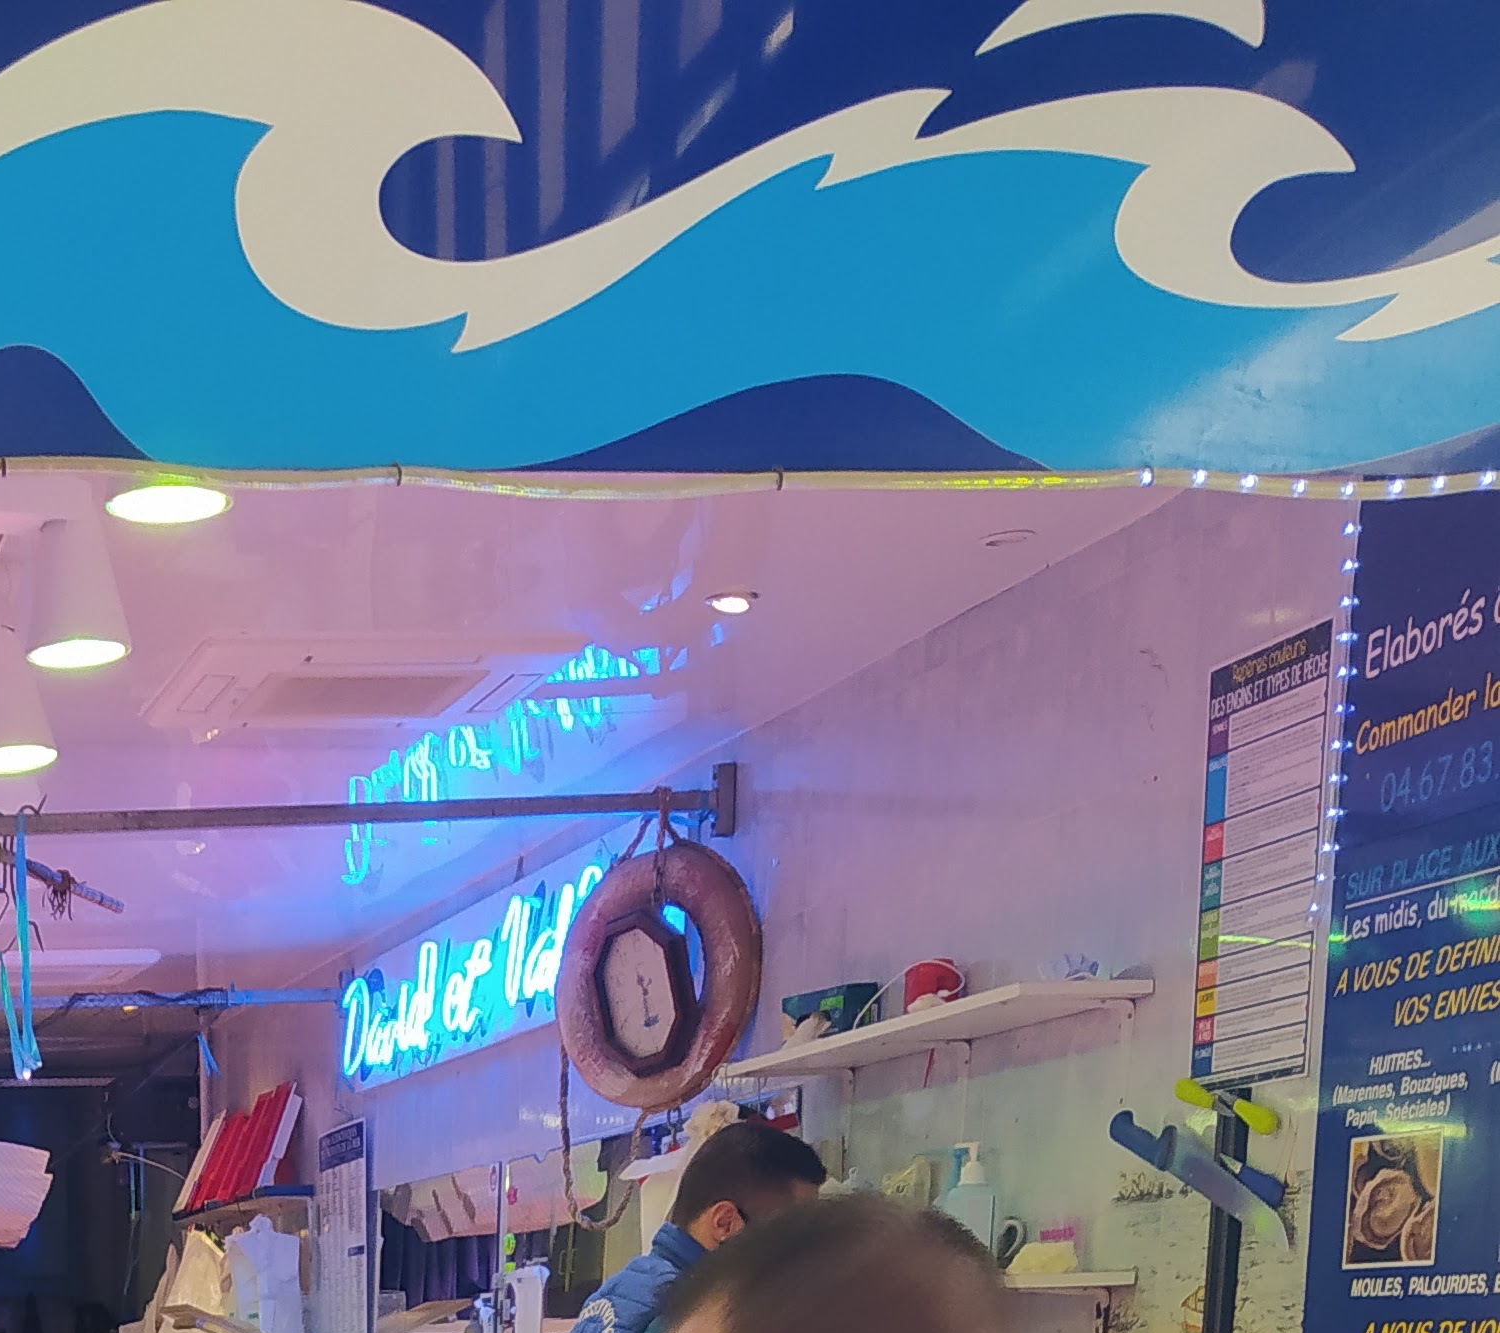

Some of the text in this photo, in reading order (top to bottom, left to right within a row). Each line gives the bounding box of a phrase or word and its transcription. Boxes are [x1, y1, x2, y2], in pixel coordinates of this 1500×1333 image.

[1365, 588, 1486, 680] Elaborés
[1267, 667, 1291, 697] TYPES
[1291, 662, 1303, 687] DE
[1355, 687, 1478, 756] Commander
[1346, 864, 1385, 900] SUR
[1389, 844, 1453, 889] PLACE
[1342, 914, 1371, 942] Les
[1374, 899, 1423, 935] midis,
[1427, 890, 1450, 921] du
[1452, 873, 1500, 915] mard
[1333, 933, 1500, 997] A VOUS DE DEFINI
[342, 940, 438, 1078] David
[442, 938, 493, 1033] et
[1393, 979, 1500, 1028] VOS ENVIES
[1332, 1081, 1397, 1107] (Marennes,
[1400, 1071, 1469, 1096] Bouzigues,
[1350, 1276, 1405, 1300] MOULES,
[1408, 1273, 1489, 1297] PALOURDES,
